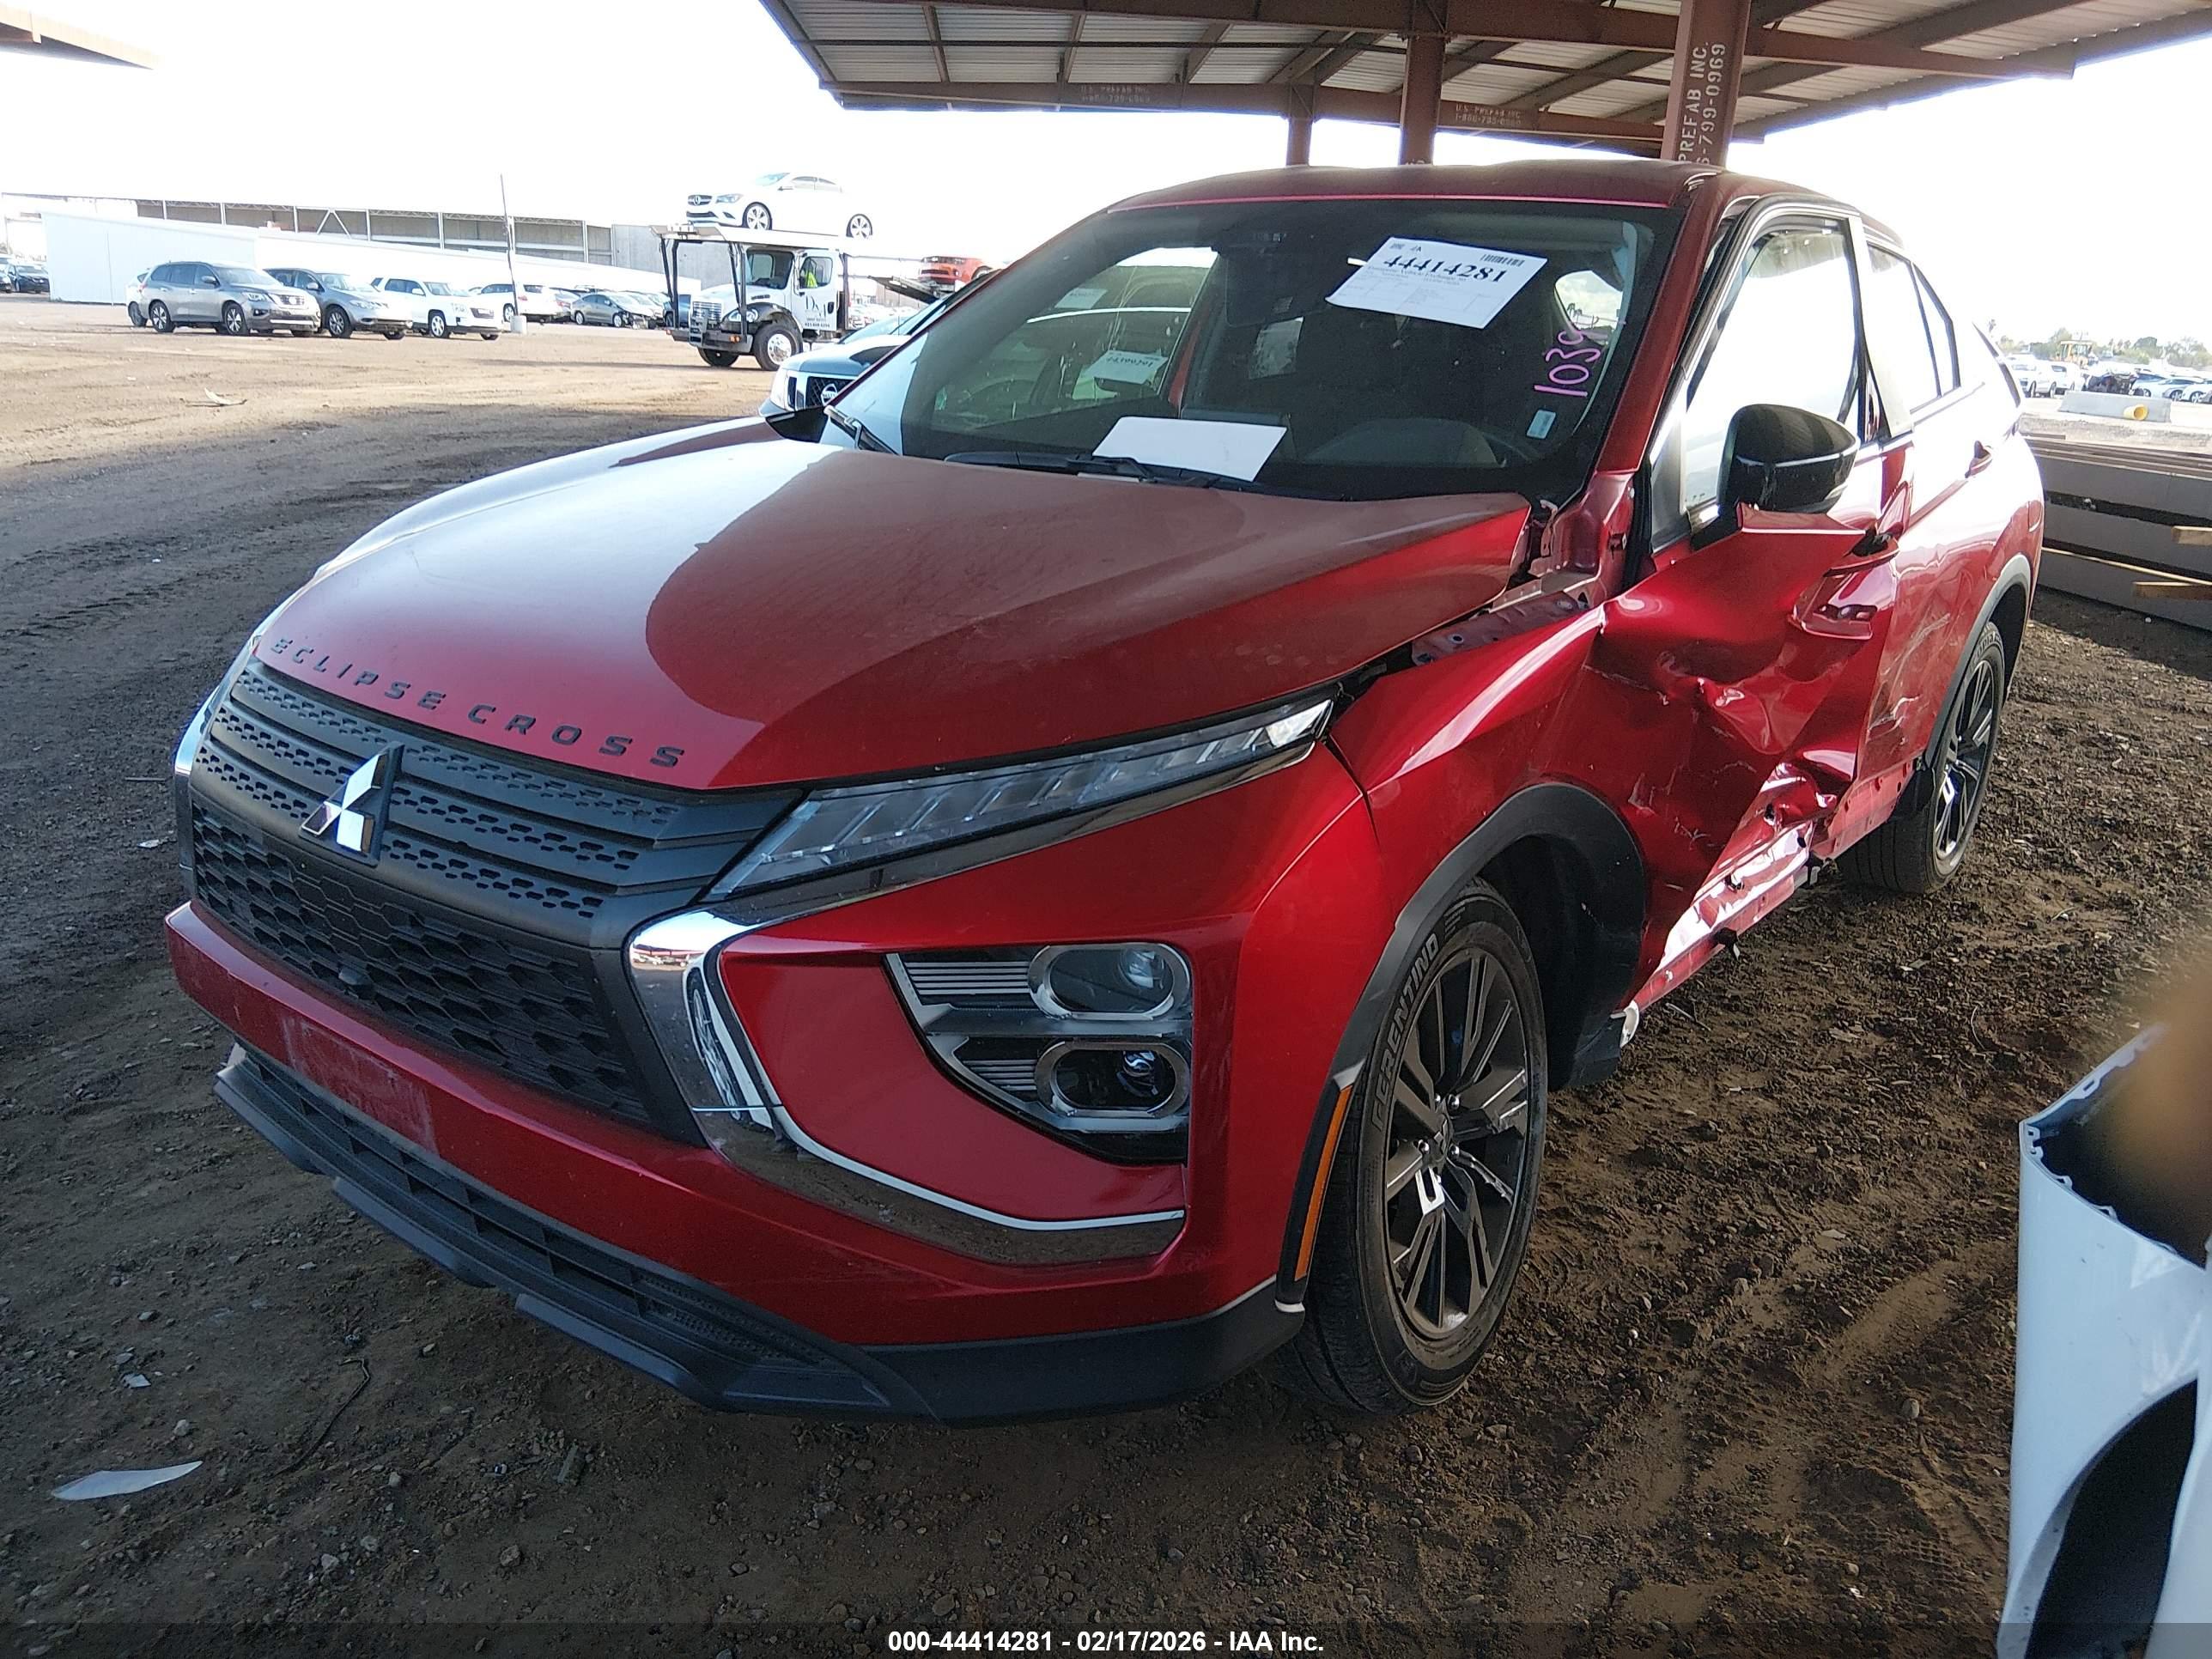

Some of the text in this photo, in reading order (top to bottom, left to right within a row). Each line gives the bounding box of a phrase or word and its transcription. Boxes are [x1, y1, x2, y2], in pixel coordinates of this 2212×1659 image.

[1678, 89, 1701, 164] PREFAB
[1383, 255, 1507, 283] 44414281
[270, 638, 684, 769] ECLIPSE CROSS
